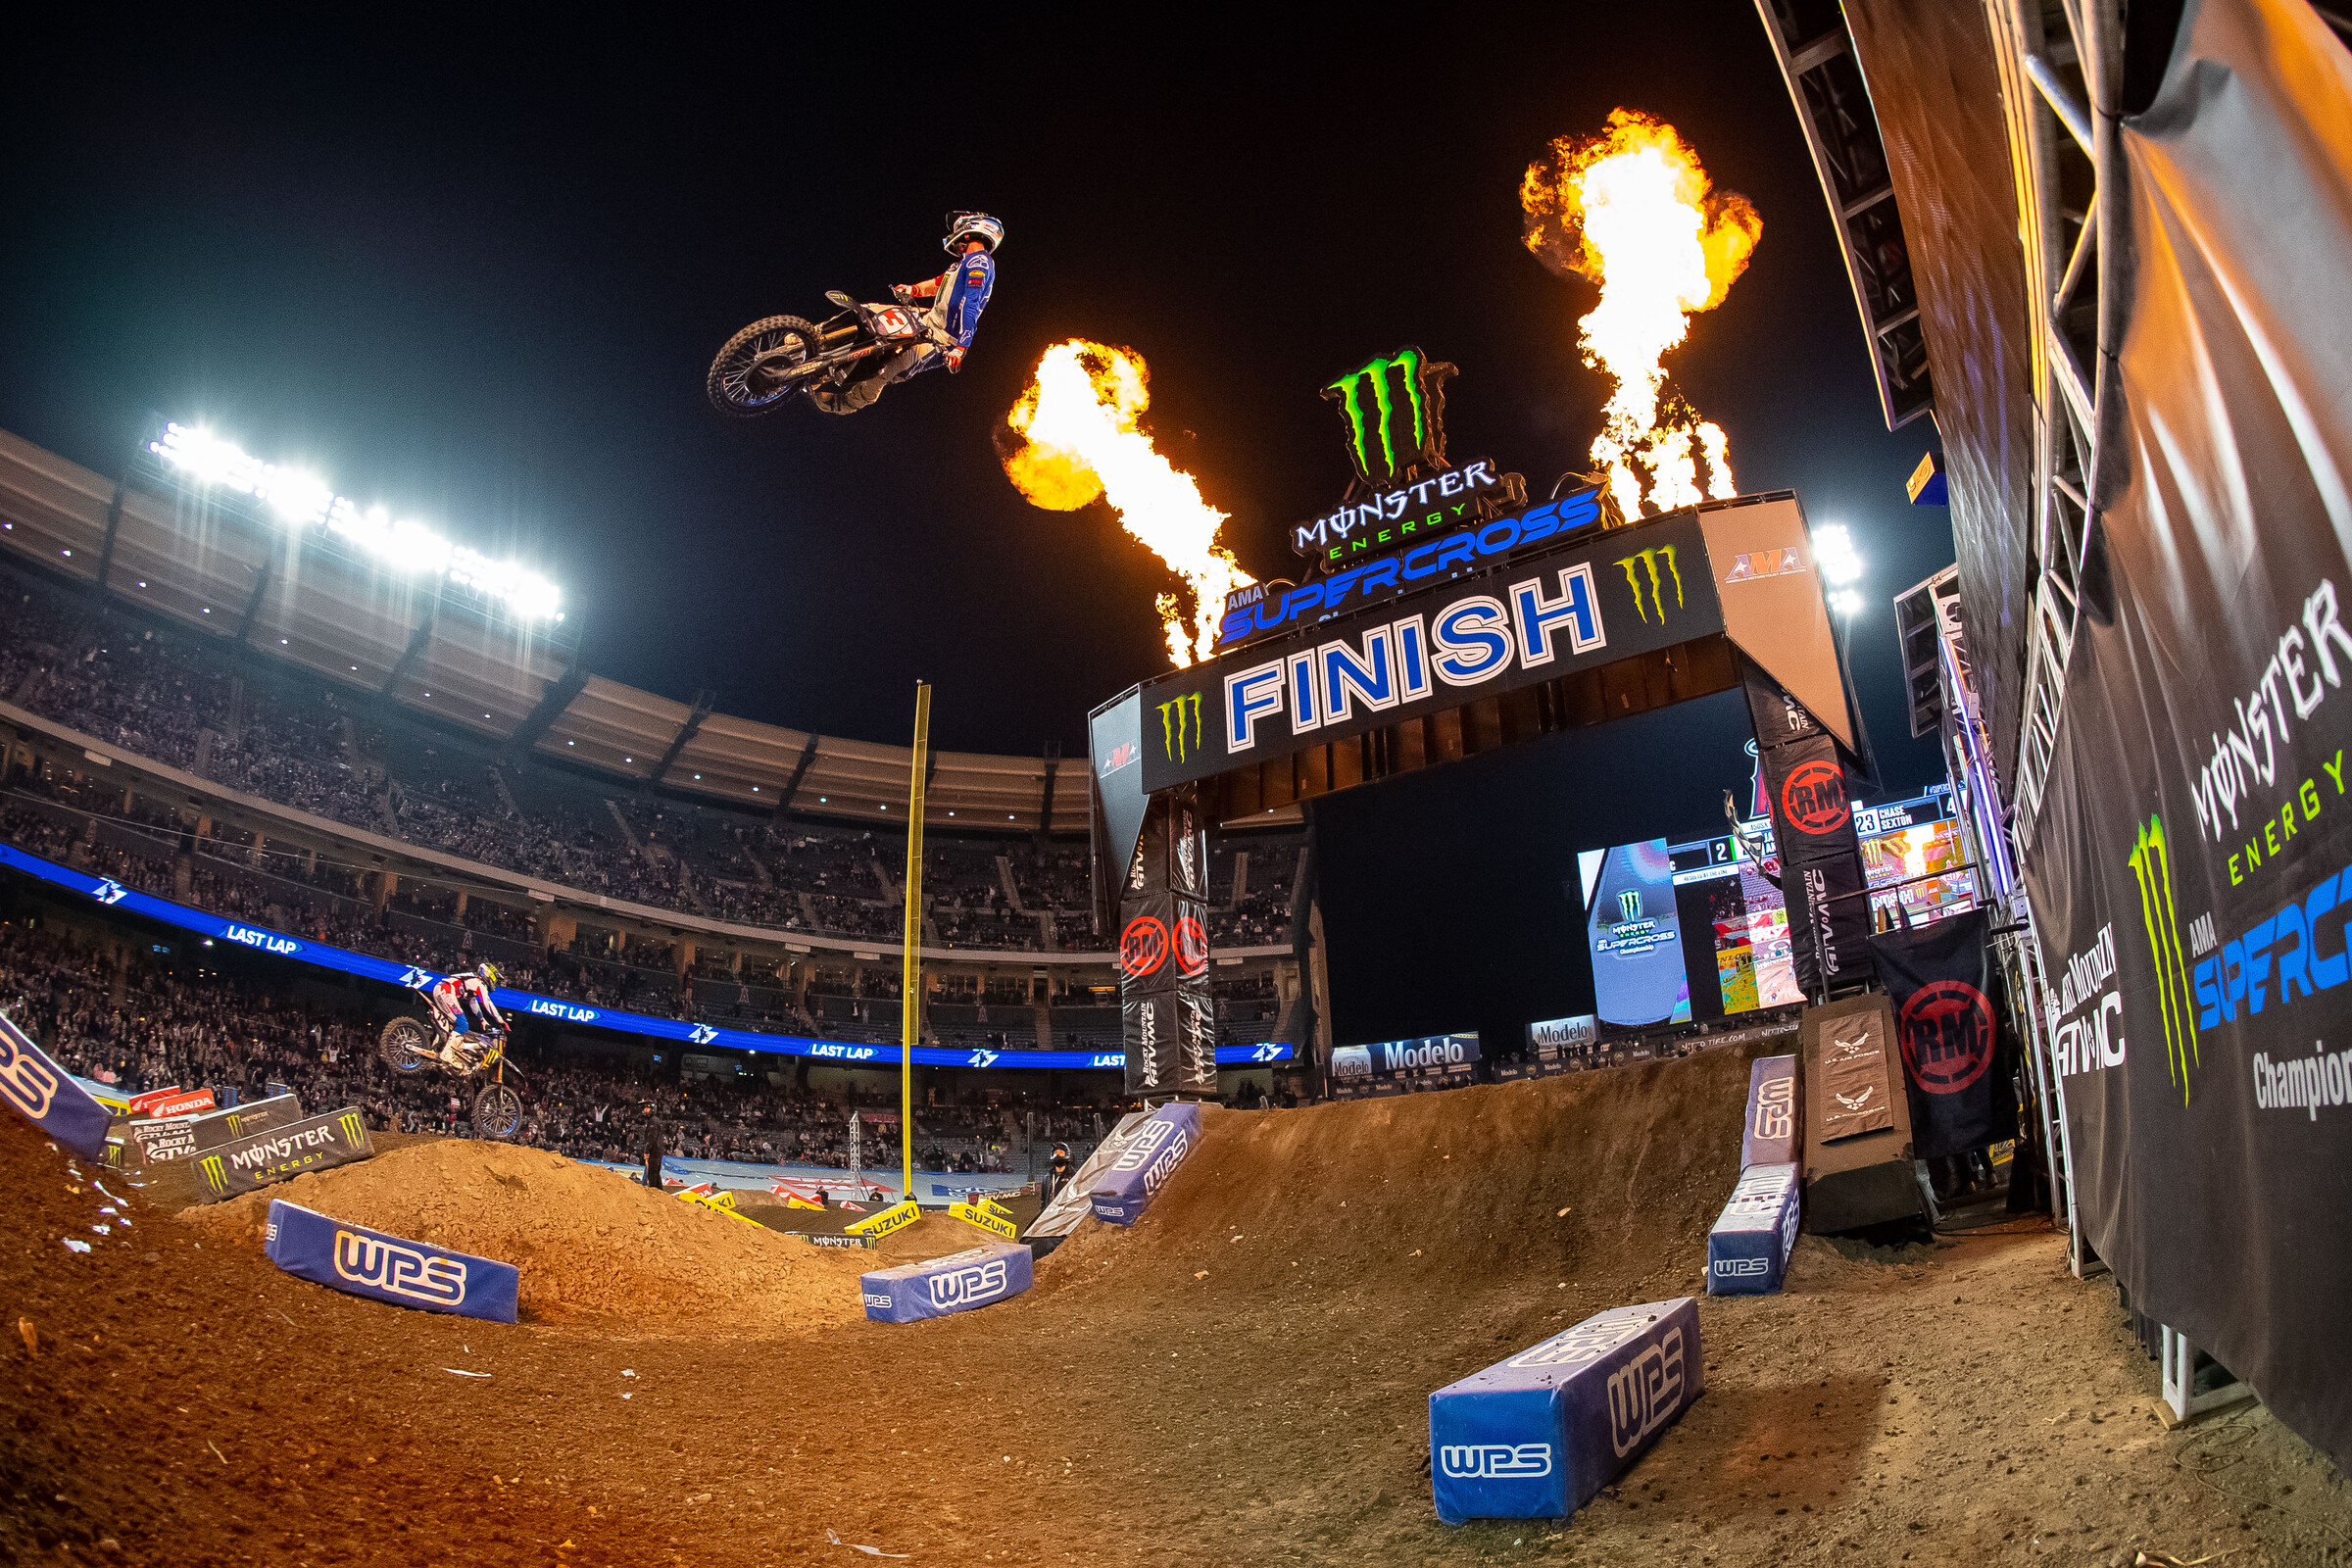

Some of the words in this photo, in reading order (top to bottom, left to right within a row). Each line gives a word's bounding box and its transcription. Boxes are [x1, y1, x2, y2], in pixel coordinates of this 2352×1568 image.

[1296, 461, 1495, 549] MONSTER
[1329, 503, 1466, 559] ENERGY
[1218, 490, 1599, 645] SUPERCROSS
[1724, 546, 1806, 580] AMA
[1227, 585, 1263, 612] AMA
[1224, 561, 1606, 754] FINISH
[2191, 578, 2352, 843] MONSTER
[1855, 814, 1876, 833] 23
[1879, 806, 1905, 820] CHASE
[1881, 814, 1913, 830] SEXTON
[2228, 749, 2344, 887] ENERGY
[1715, 843, 1728, 861] 2
[226, 925, 266, 947] LAST
[266, 936, 297, 955] LAP
[1596, 931, 1675, 952] SUPERCROSS
[1612, 921, 1655, 934] MONSTER
[2189, 910, 2217, 957] AMA
[1619, 944, 1654, 955] Championship
[2193, 863, 2352, 1030] SUPERC
[531, 1000, 566, 1017] LAST
[568, 1007, 595, 1022] LAP
[1540, 1021, 1589, 1045] Modelo
[1708, 1033, 1745, 1046] TIRE.COM
[811, 1044, 845, 1057] LAST
[846, 1047, 873, 1059] LAP
[1094, 1054, 1126, 1066] LAST
[1384, 1037, 1464, 1071] Modelo
[1334, 1060, 1370, 1076] Modelo
[165, 1097, 213, 1114] HONDA
[158, 1137, 187, 1148] ROCKY
[230, 1125, 335, 1170] MONSTER
[1111, 1120, 1175, 1172] WPS
[255, 1152, 324, 1180] ENERGY
[1143, 1129, 1189, 1196] WPS
[862, 1206, 916, 1236] SUZUKI
[964, 1208, 1013, 1237] SUZUKI
[1095, 1204, 1125, 1217] WPS
[813, 1236, 862, 1248] MONSTER
[334, 1230, 467, 1306] WPS
[1714, 1257, 1769, 1277] WPS
[929, 1260, 1006, 1309] WPS
[864, 1294, 893, 1309] WPS
[1607, 1327, 1685, 1458] WPS
[1441, 1443, 1551, 1478] WPS
